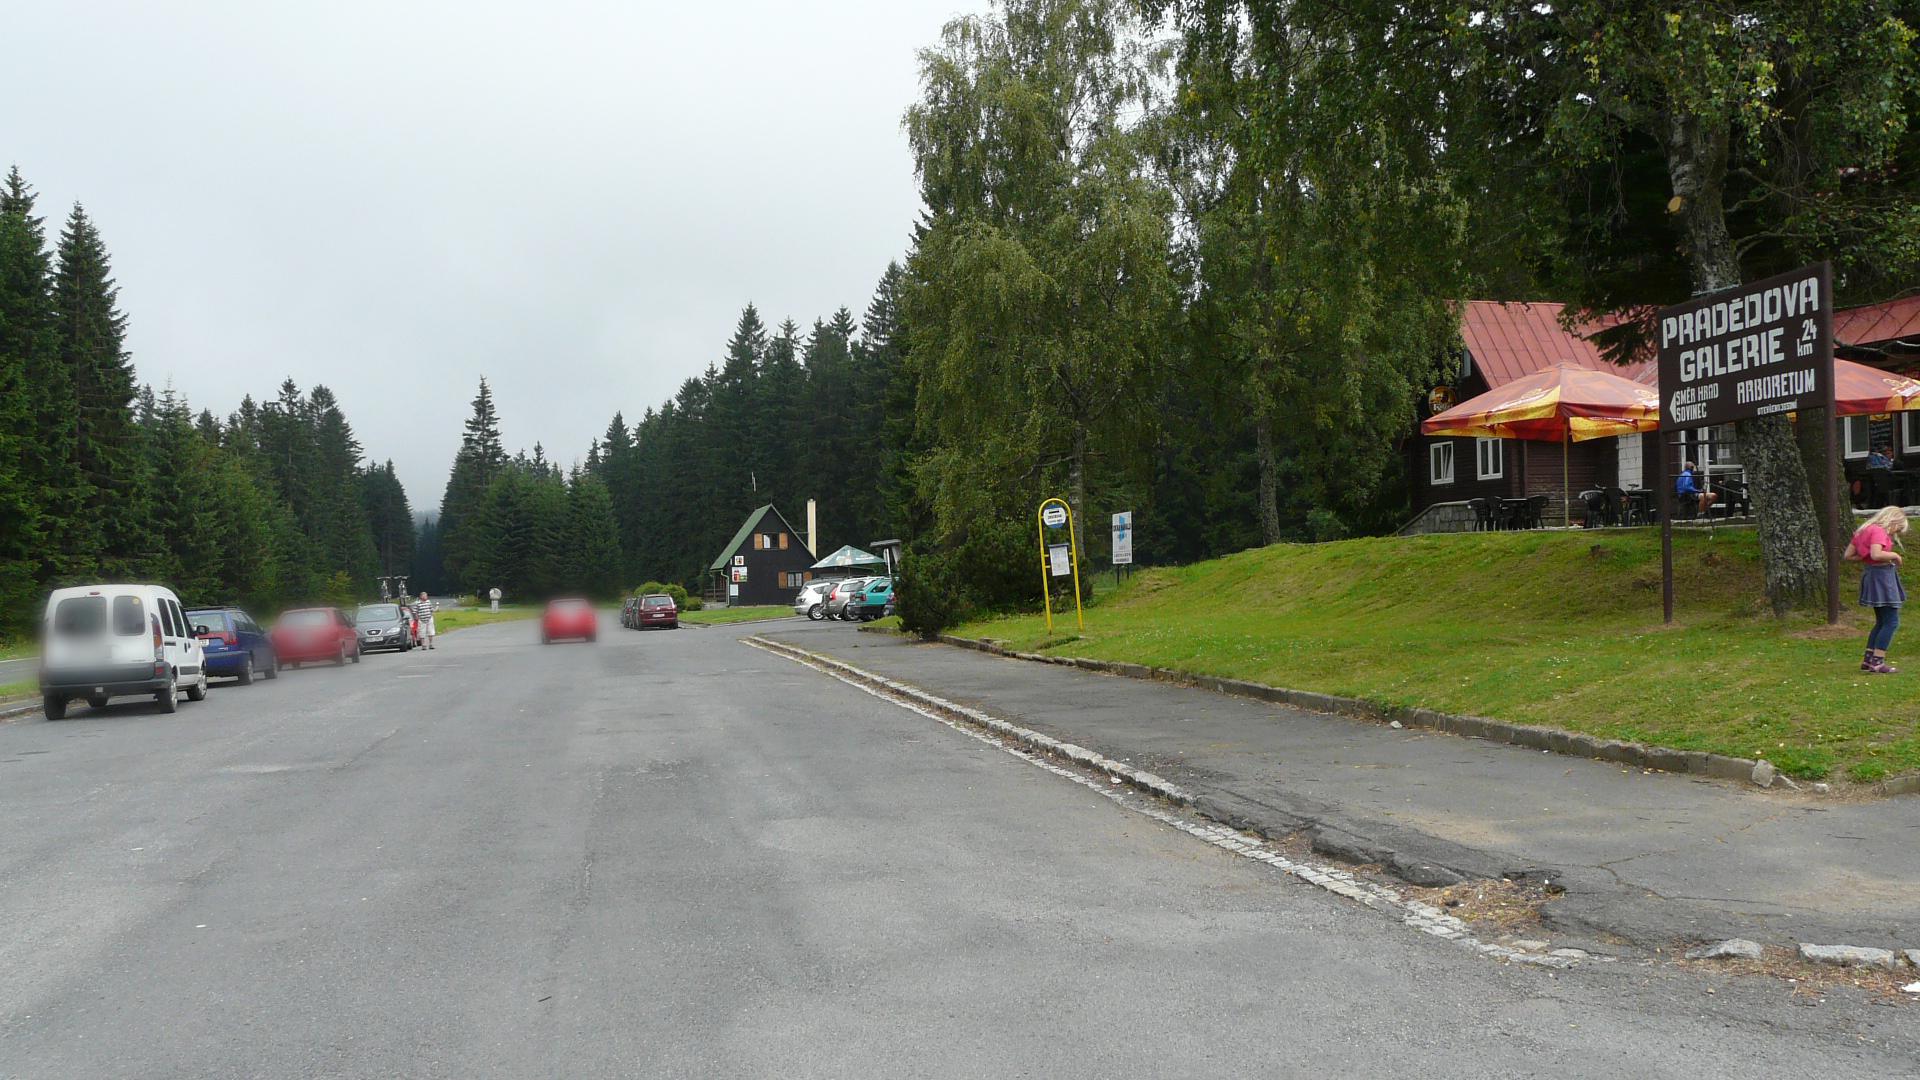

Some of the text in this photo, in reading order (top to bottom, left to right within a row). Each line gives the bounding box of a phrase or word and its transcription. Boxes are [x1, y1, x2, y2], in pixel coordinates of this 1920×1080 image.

[1662, 277, 1819, 349] PRADĚDOVA
[1802, 319, 1817, 341] 24
[1680, 328, 1785, 383] GALERIE
[1797, 338, 1813, 356] km
[1676, 388, 1696, 405] SMĚR
[1698, 383, 1719, 402] HRAD
[1737, 368, 1815, 405] ARBORETUM
[1676, 403, 1707, 423] SOVINEC
